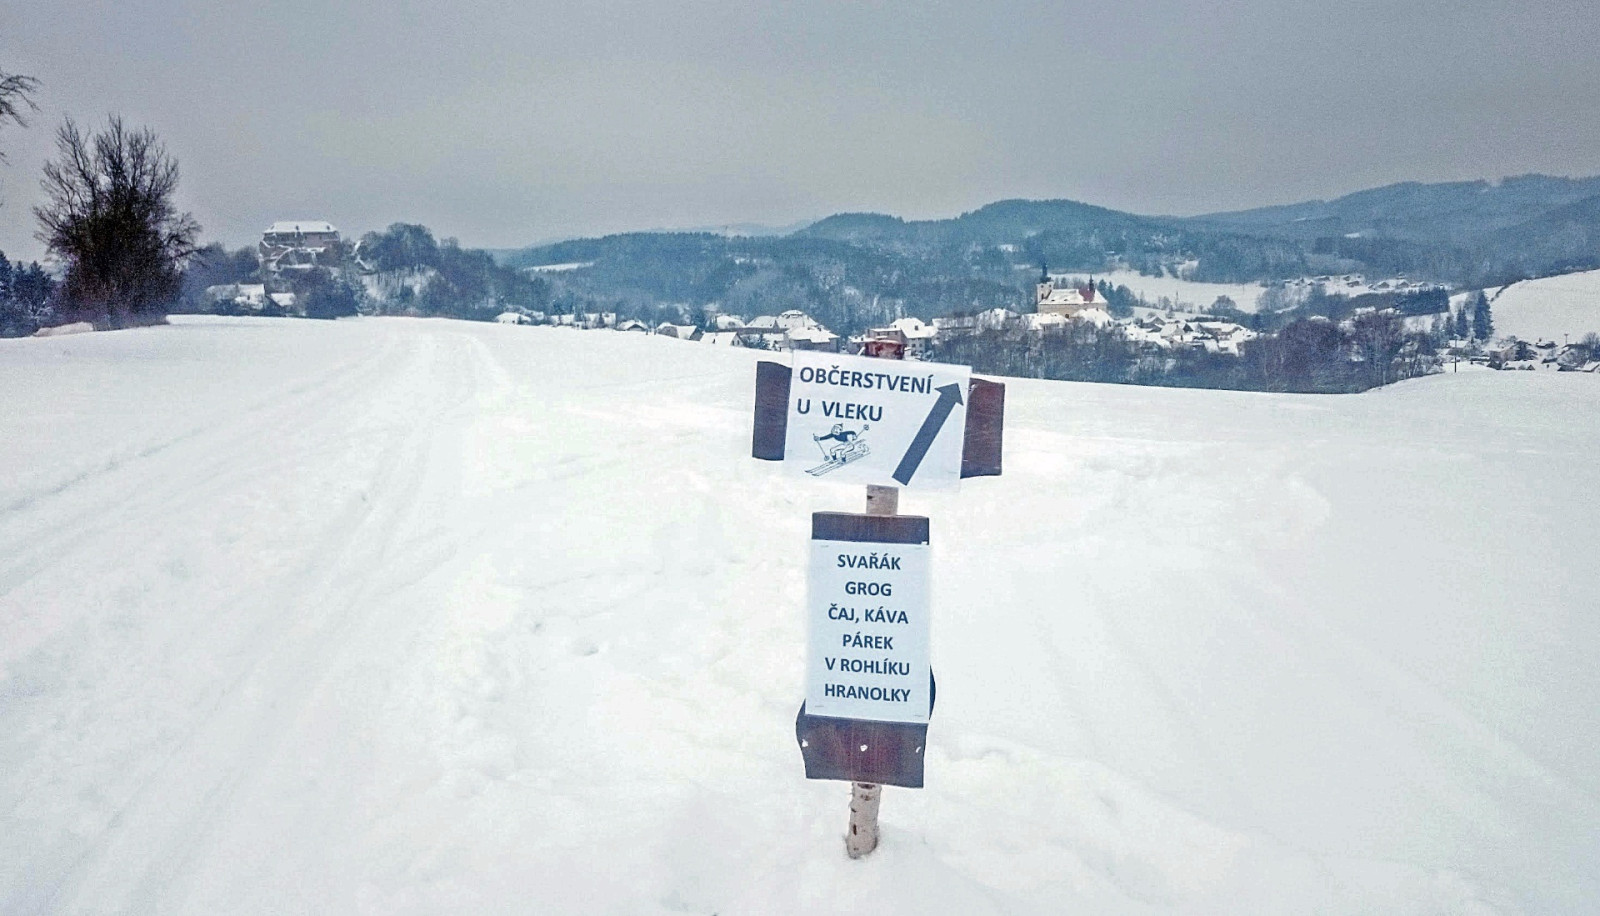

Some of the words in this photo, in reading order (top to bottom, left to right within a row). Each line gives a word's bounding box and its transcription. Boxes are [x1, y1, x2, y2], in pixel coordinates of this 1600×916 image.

[799, 364, 934, 395] OBČERSTVENÍ
[797, 398, 811, 415] U
[822, 400, 883, 422] VLEKU
[837, 552, 901, 571] SVAŘÁK
[845, 581, 892, 597] GROG
[828, 602, 860, 624] ČAJ,
[864, 605, 909, 625] KÁVA
[842, 631, 894, 650] PÁREK
[825, 656, 836, 671] V
[840, 657, 910, 676] ROHLÍKU
[824, 683, 911, 703] HRANOLKY
